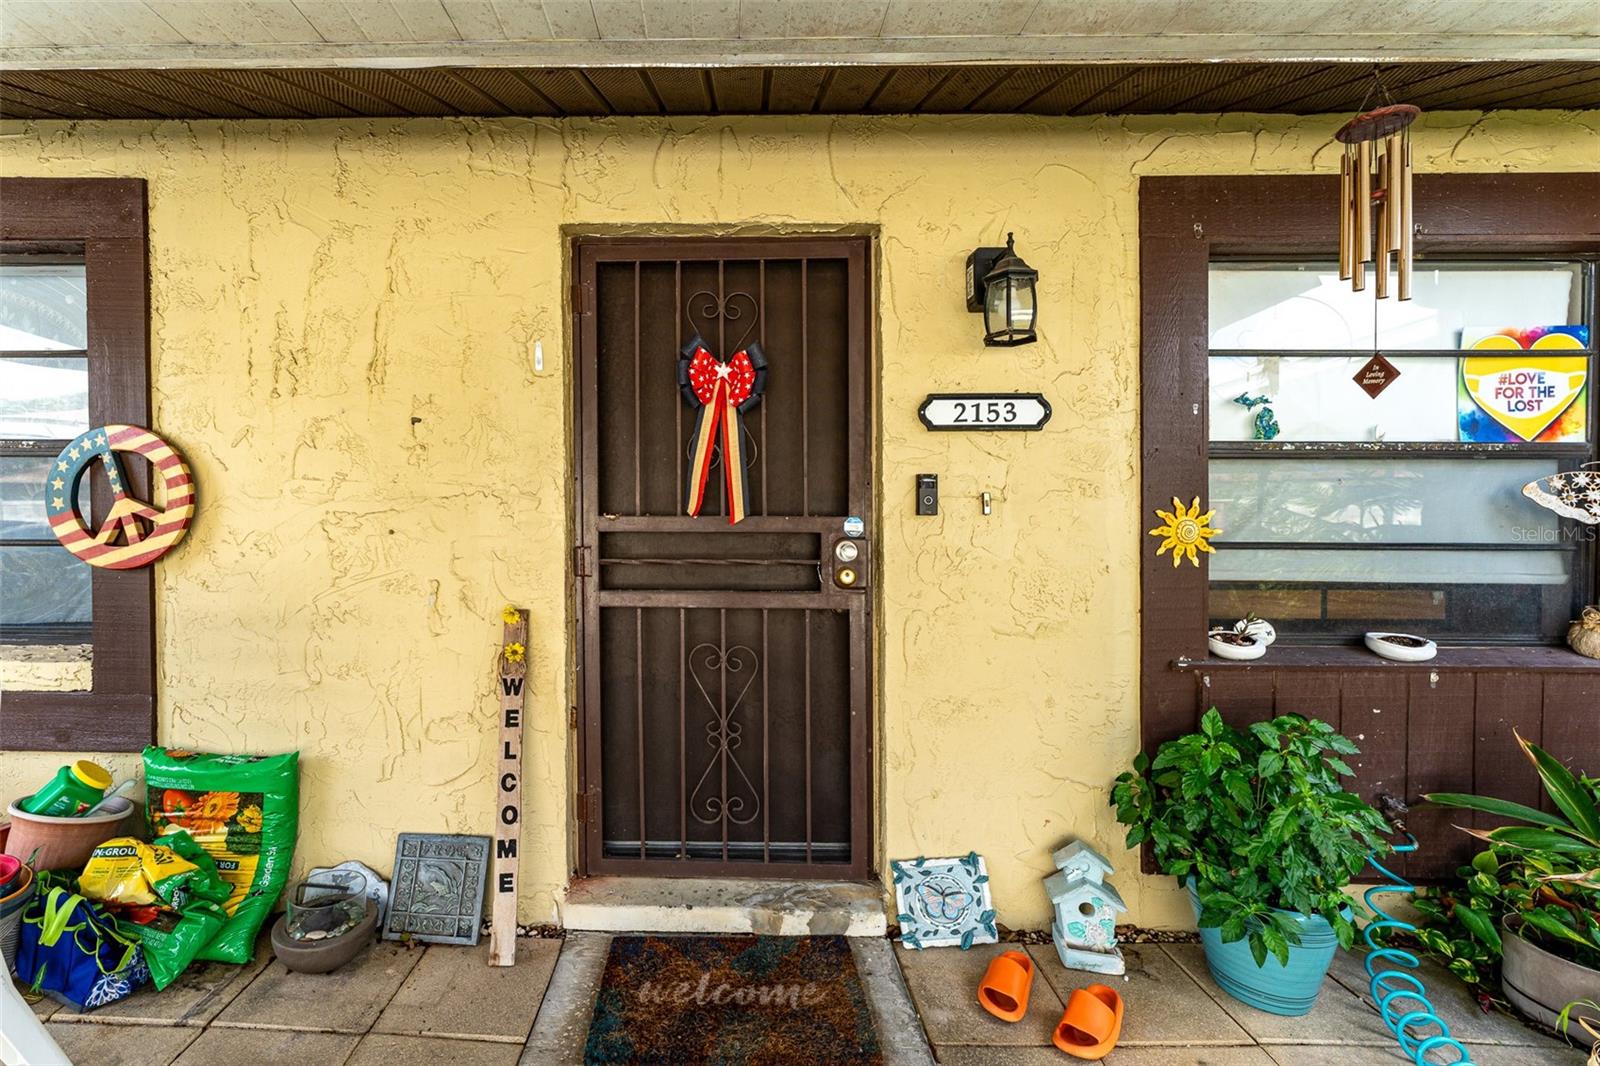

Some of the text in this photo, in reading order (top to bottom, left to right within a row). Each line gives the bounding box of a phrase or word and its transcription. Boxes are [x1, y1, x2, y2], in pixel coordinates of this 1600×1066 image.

[1498, 372, 1546, 385] #LOVE
[1495, 385, 1555, 399] FOR THE
[953, 402, 1017, 423] 2153
[1507, 400, 1543, 412] LOST
[496, 677, 524, 893] WELCOME
[639, 972, 829, 1010] welcome
